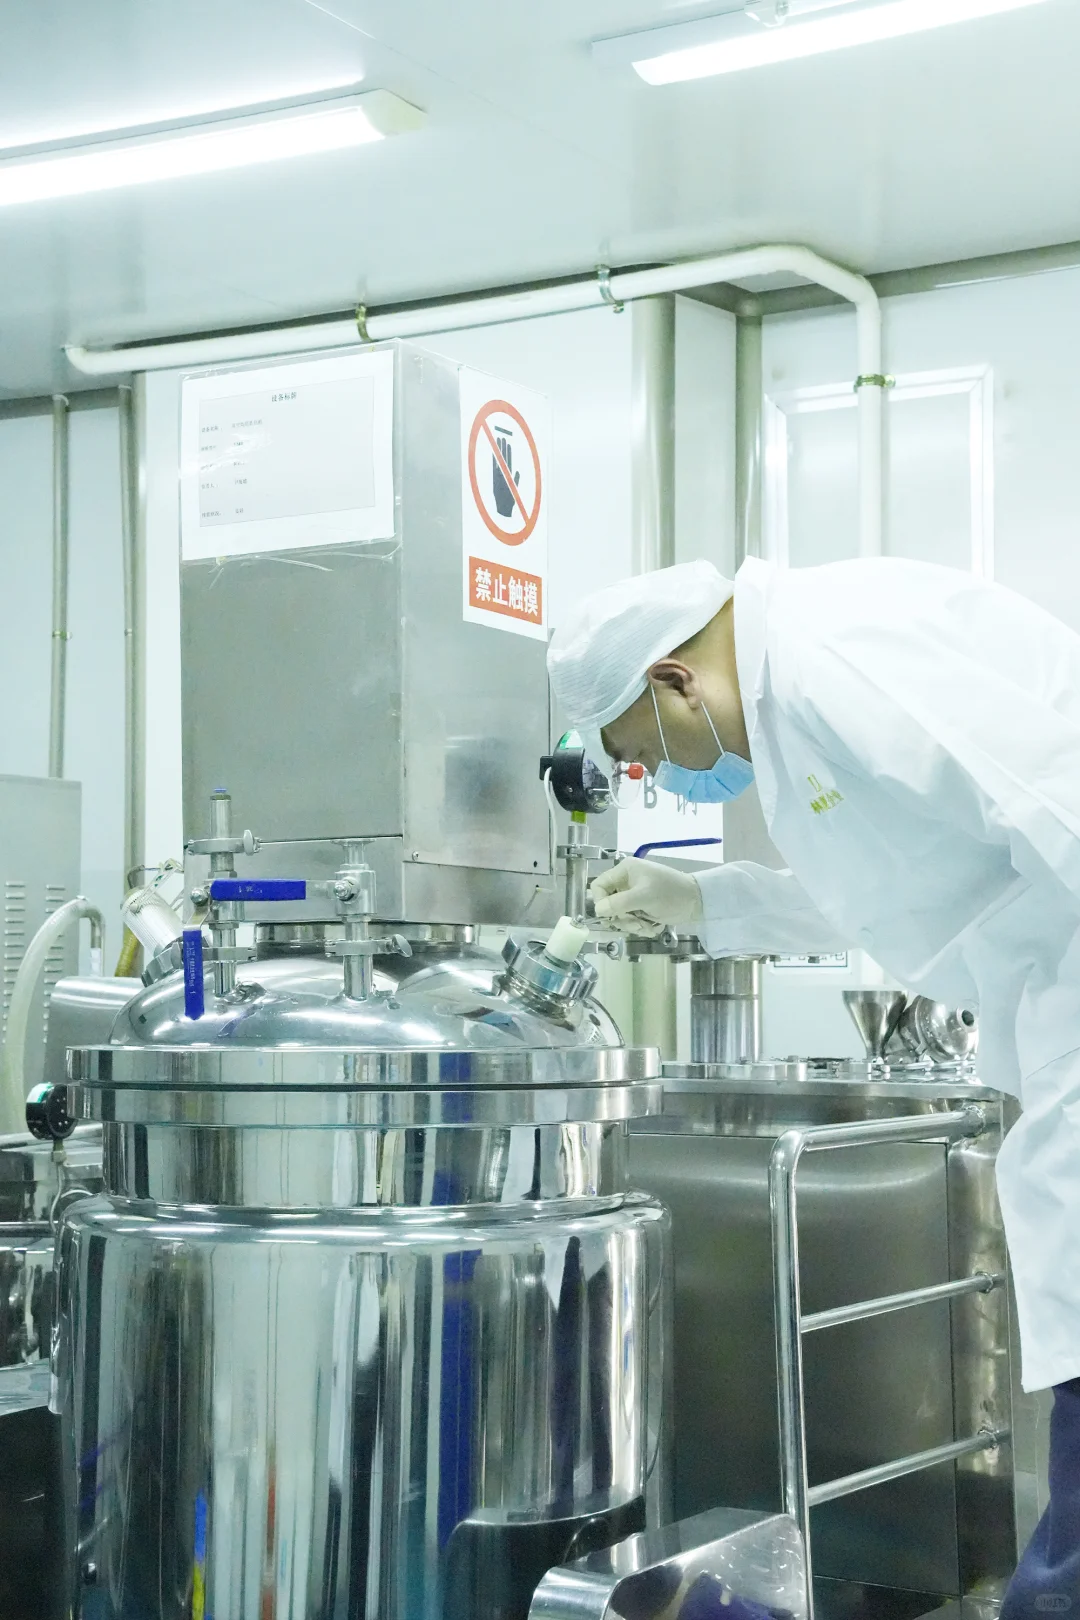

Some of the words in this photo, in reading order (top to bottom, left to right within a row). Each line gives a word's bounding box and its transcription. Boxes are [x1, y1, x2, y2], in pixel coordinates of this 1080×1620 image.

[475, 567, 538, 616] 禁止触摸
[643, 770, 657, 809] B
